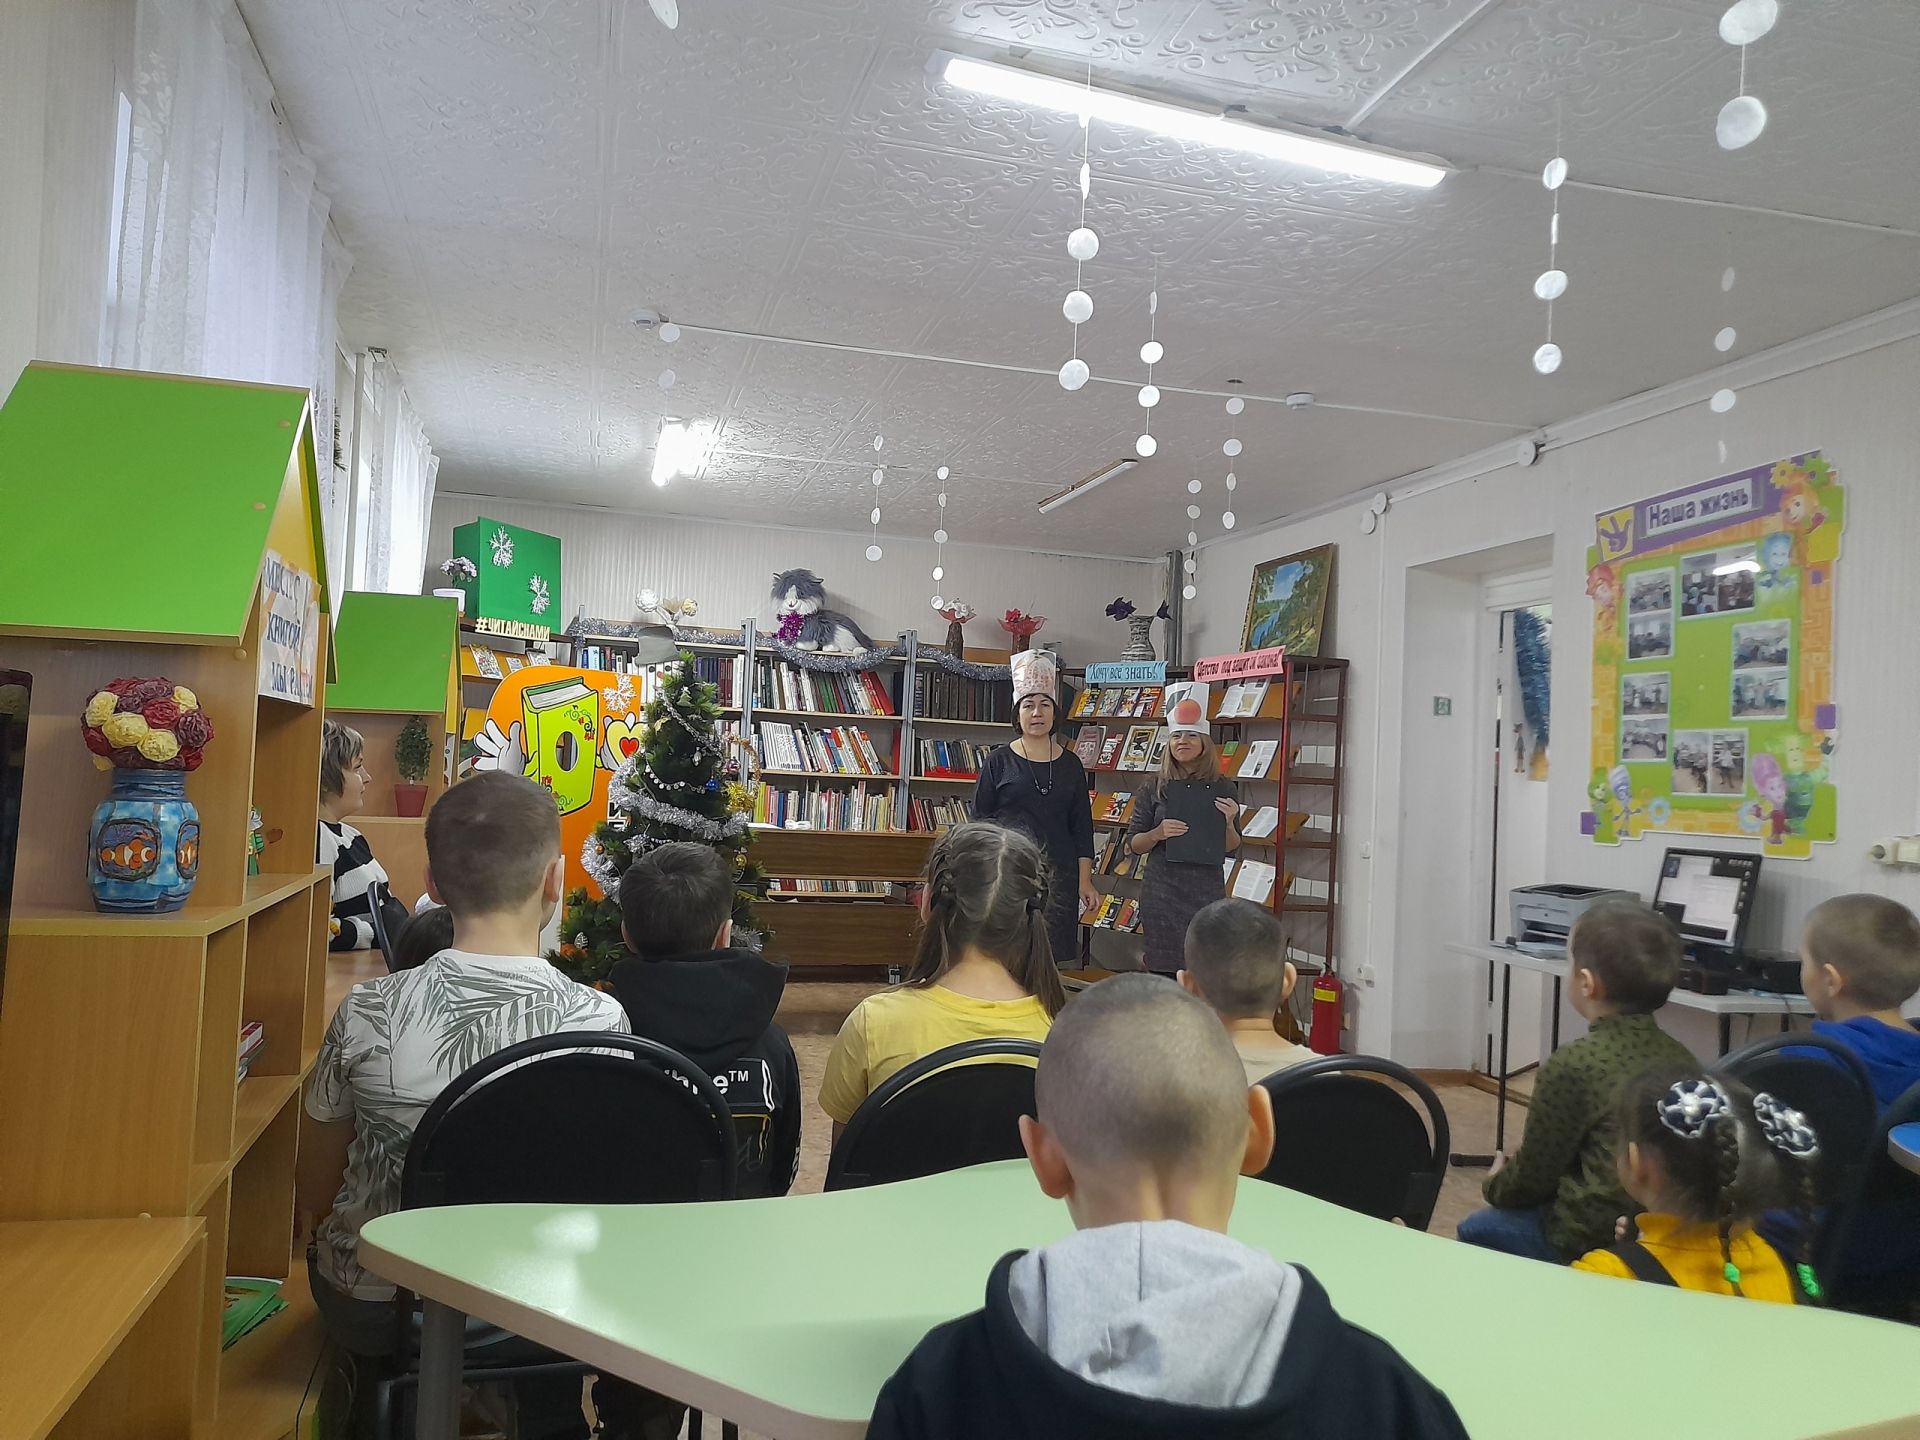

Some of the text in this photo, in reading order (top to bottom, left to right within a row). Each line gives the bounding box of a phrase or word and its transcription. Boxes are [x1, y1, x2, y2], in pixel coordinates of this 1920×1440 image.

[1649, 488, 1749, 530] Наша жизнь
[264, 556, 293, 600] МЕСТЕ
[267, 611, 301, 653] КНИГОЙ
[475, 616, 550, 642] #ЧИТАЙСНАМИ
[271, 661, 287, 693] МЫ
